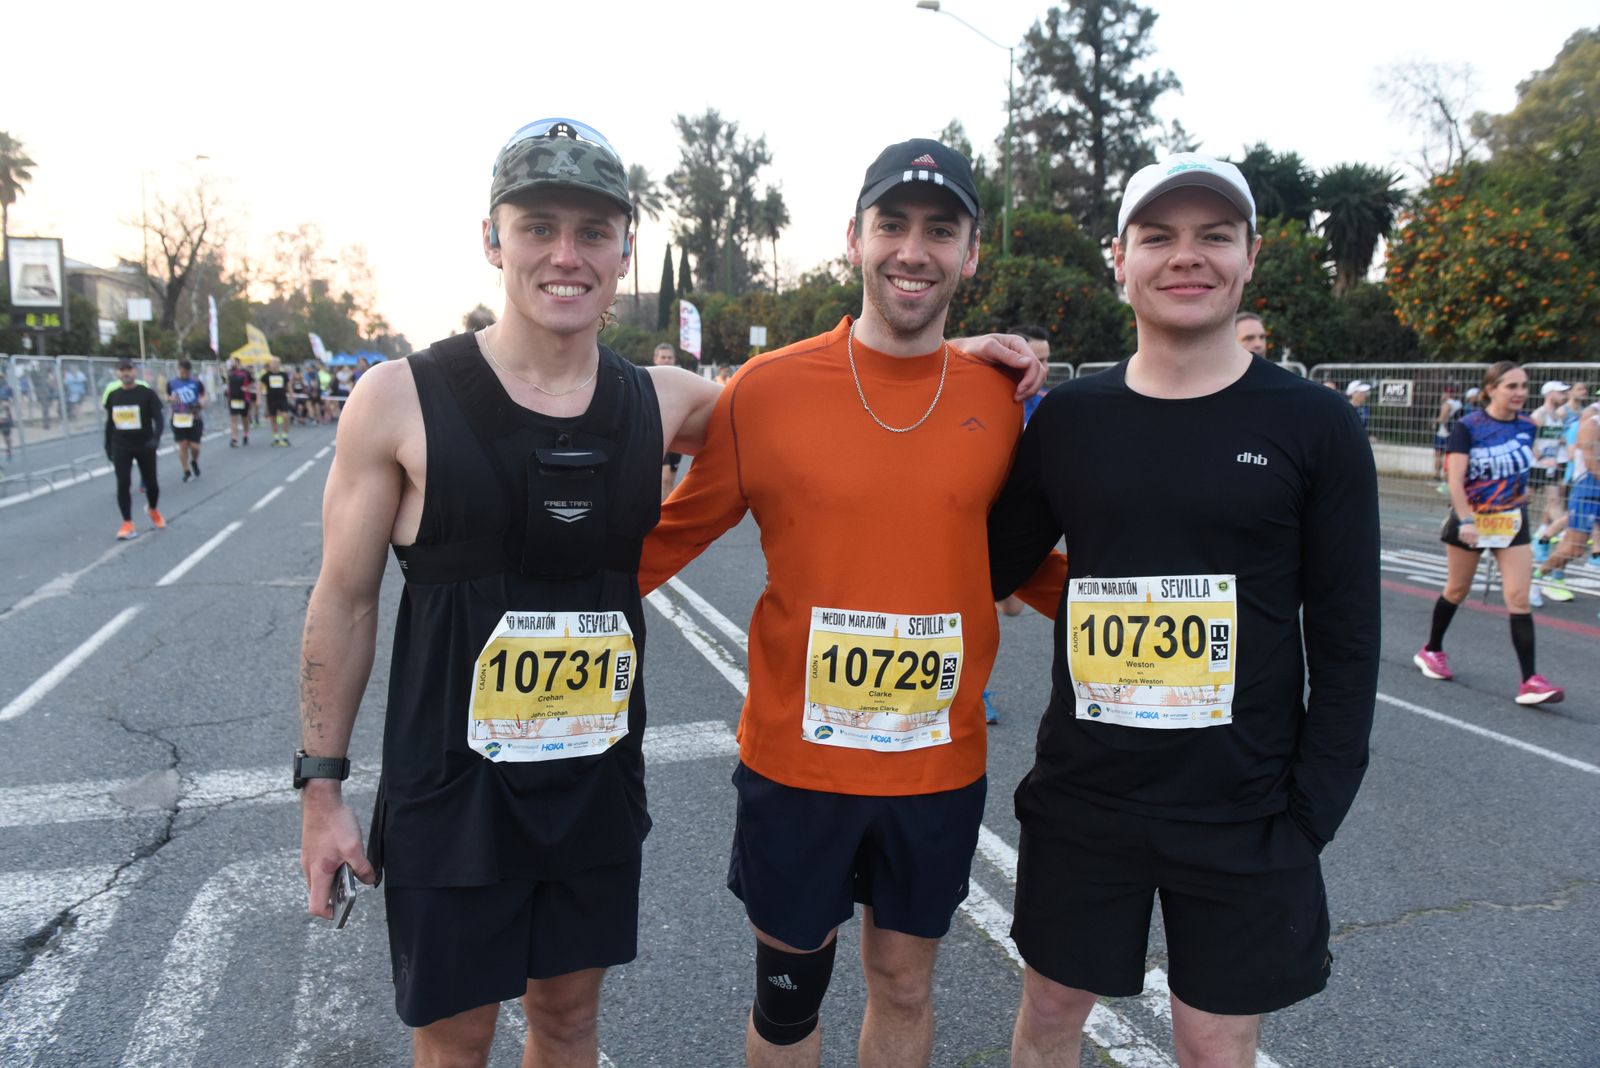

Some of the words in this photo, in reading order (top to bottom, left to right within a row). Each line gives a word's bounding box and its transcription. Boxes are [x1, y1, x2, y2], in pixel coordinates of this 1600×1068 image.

[1237, 452, 1268, 465] dhb
[1077, 581, 1100, 595] MEDIO
[1101, 579, 1138, 596] MARATÓN
[1161, 578, 1210, 599] SEVILLA
[517, 613, 556, 630] MARATÓN
[578, 613, 618, 634] SEVILLA
[822, 612, 846, 627] MEDIO
[848, 613, 887, 630] MARATÓN
[908, 616, 944, 636] SEVILLA
[1080, 614, 1206, 659] 10730
[822, 644, 941, 691] 10729
[1125, 660, 1155, 669] Weston
[489, 648, 611, 694] 10731
[1118, 677, 1138, 685] Angus
[537, 694, 564, 703] Crehan
[868, 690, 892, 698] Clarke
[530, 711, 546, 719] John
[547, 709, 568, 717] Crehan
[1135, 711, 1159, 720] HOKA
[870, 734, 892, 744] HOKA
[541, 742, 564, 752] HOKA
[768, 976, 798, 990] adidas
